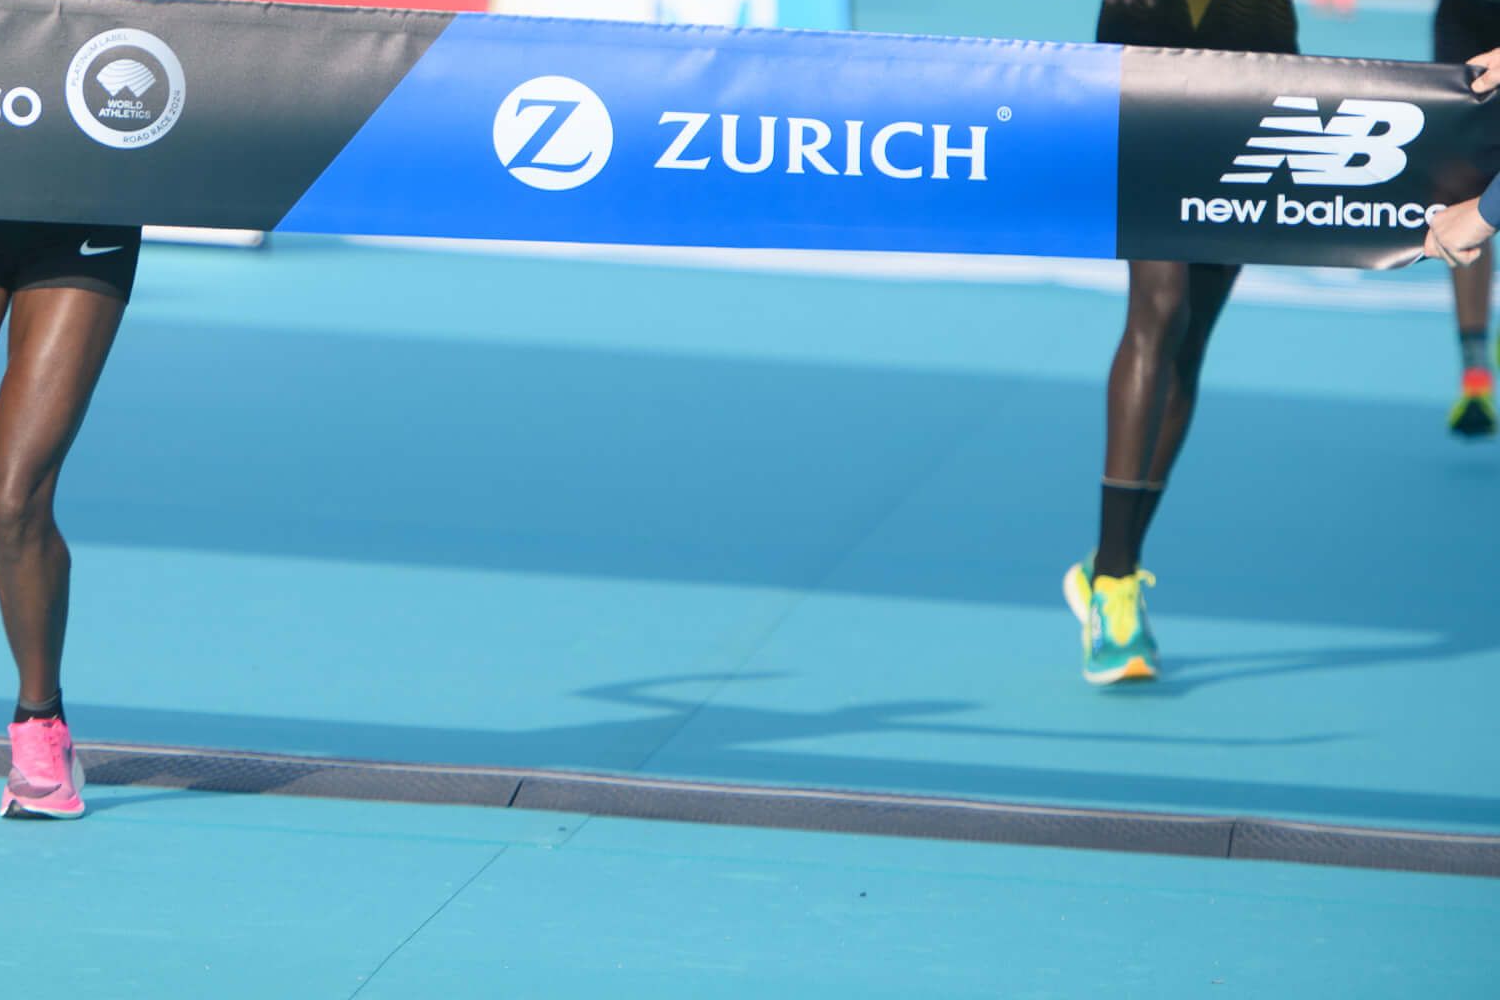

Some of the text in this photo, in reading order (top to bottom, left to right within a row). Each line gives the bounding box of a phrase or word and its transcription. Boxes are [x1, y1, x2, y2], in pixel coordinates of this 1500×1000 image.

[98, 108, 151, 119] ATHLETICS
[107, 99, 143, 109] WORLD
[123, 132, 151, 144] ROAD
[151, 116, 174, 136] RACE
[654, 111, 989, 181] ZURICH
[1180, 197, 1268, 224] new
